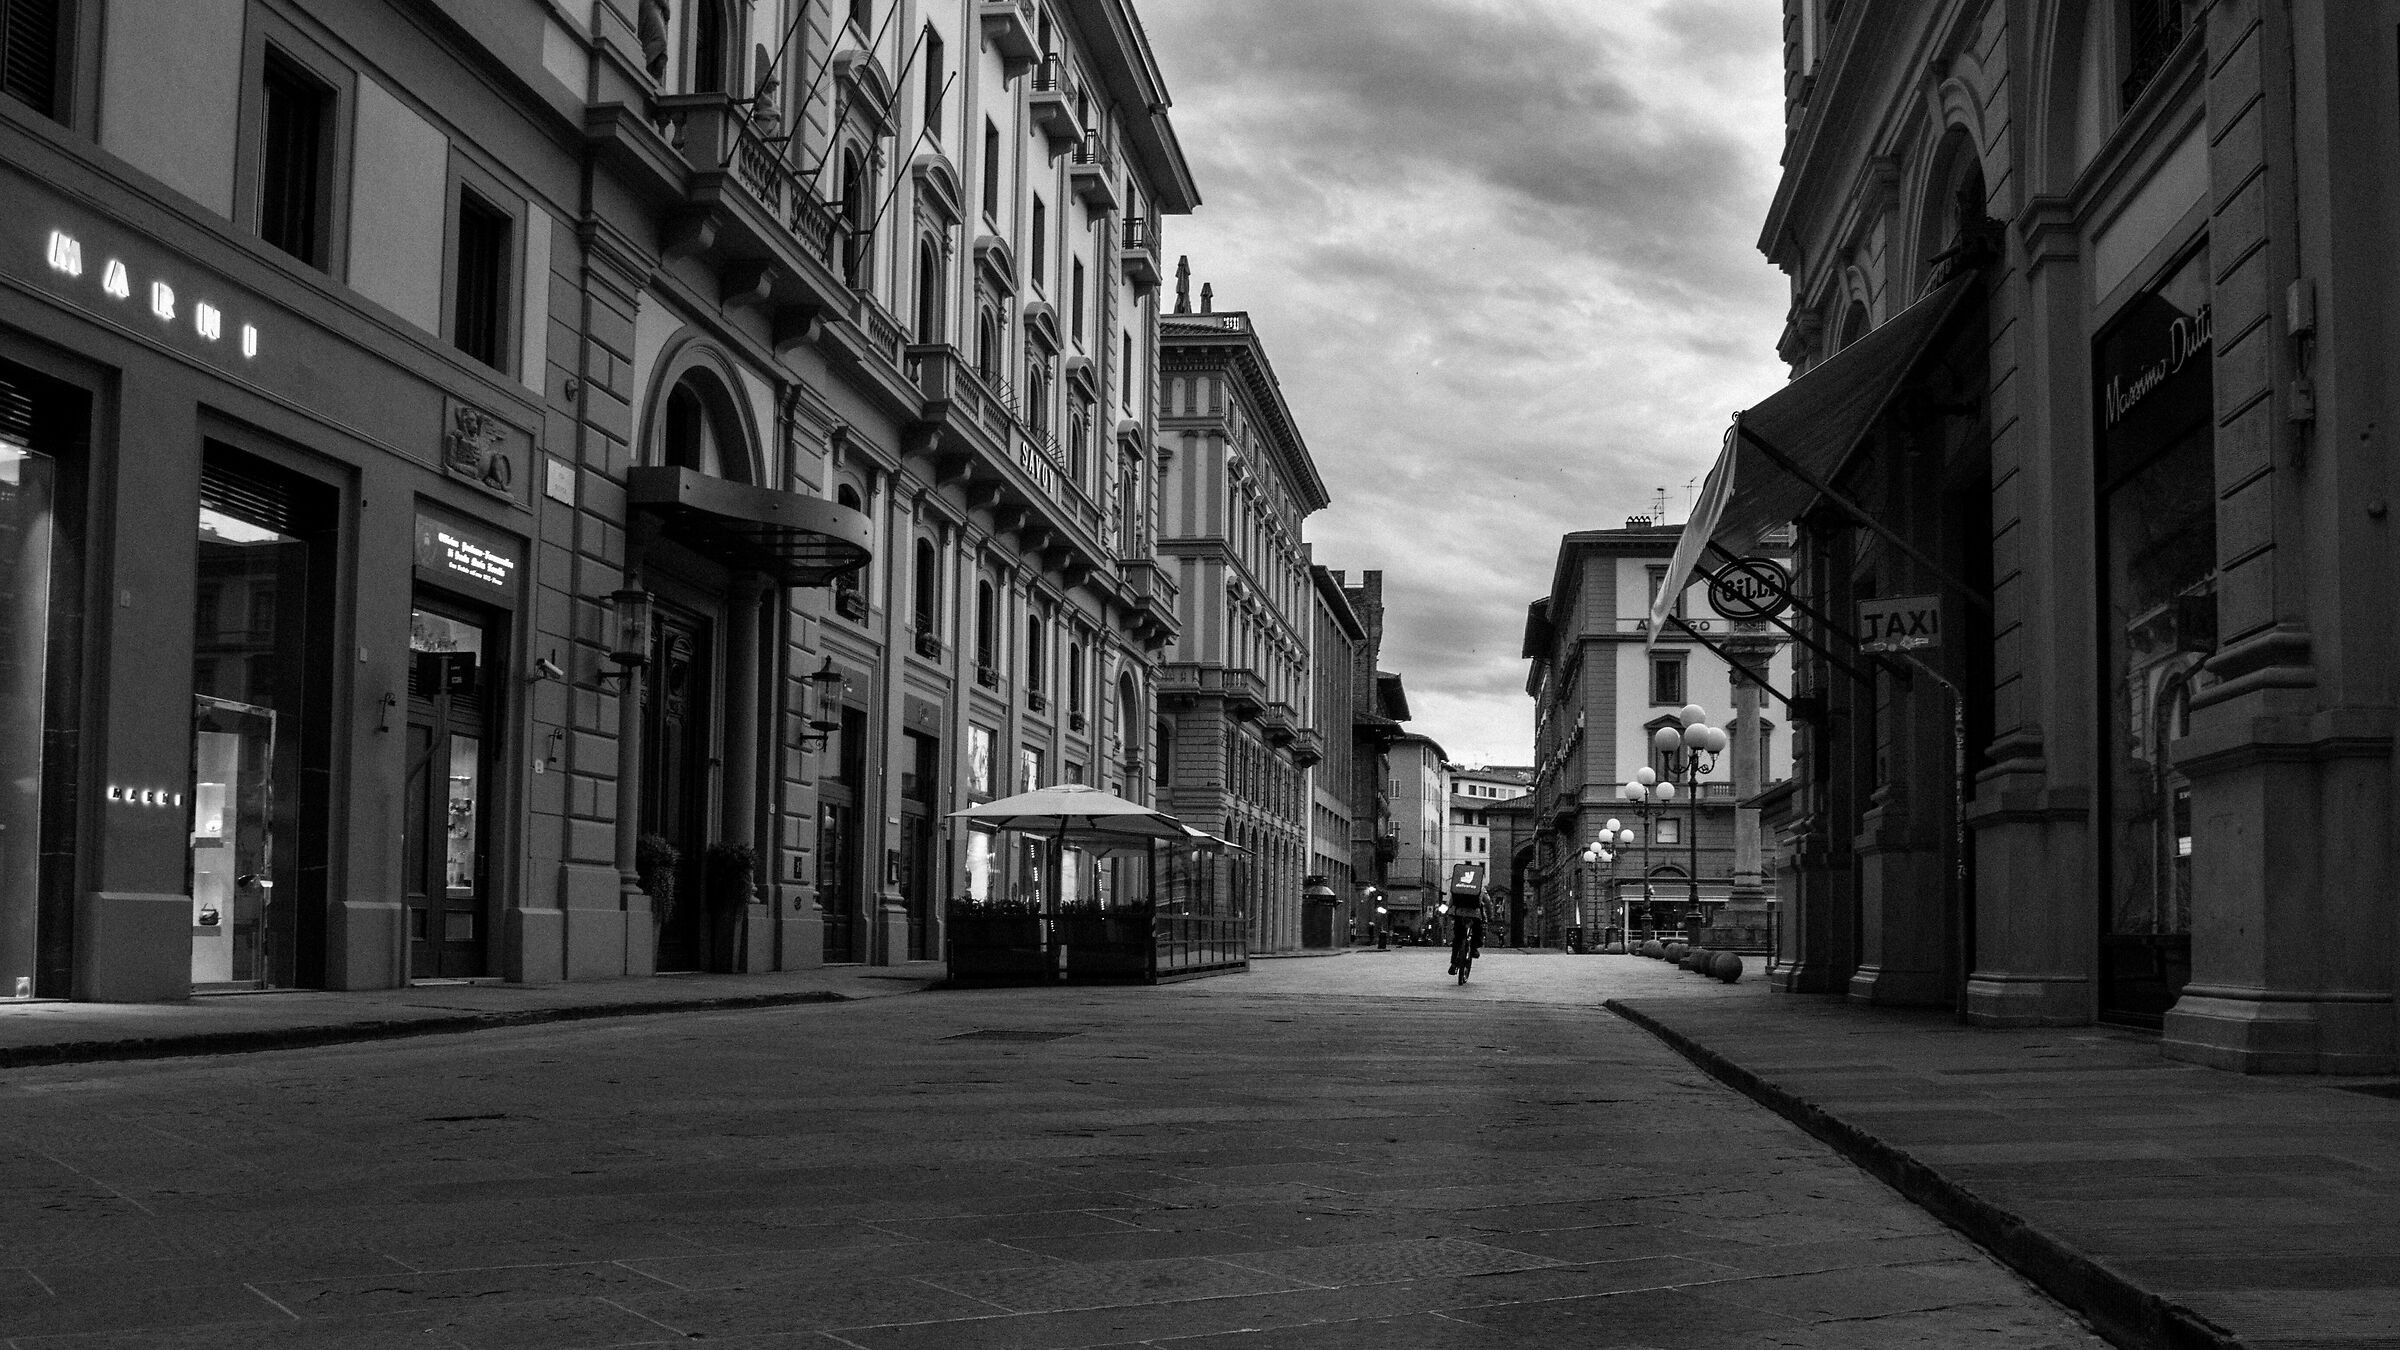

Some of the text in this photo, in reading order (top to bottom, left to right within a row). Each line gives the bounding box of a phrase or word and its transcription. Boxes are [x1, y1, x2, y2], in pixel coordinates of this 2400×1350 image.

[48, 231, 258, 358] MARNI
[2105, 306, 2212, 430] Massimo Dutti
[1020, 441, 1055, 493] SAVOY
[1862, 609, 1938, 643] TAXI
[107, 785, 184, 807] MARNI
